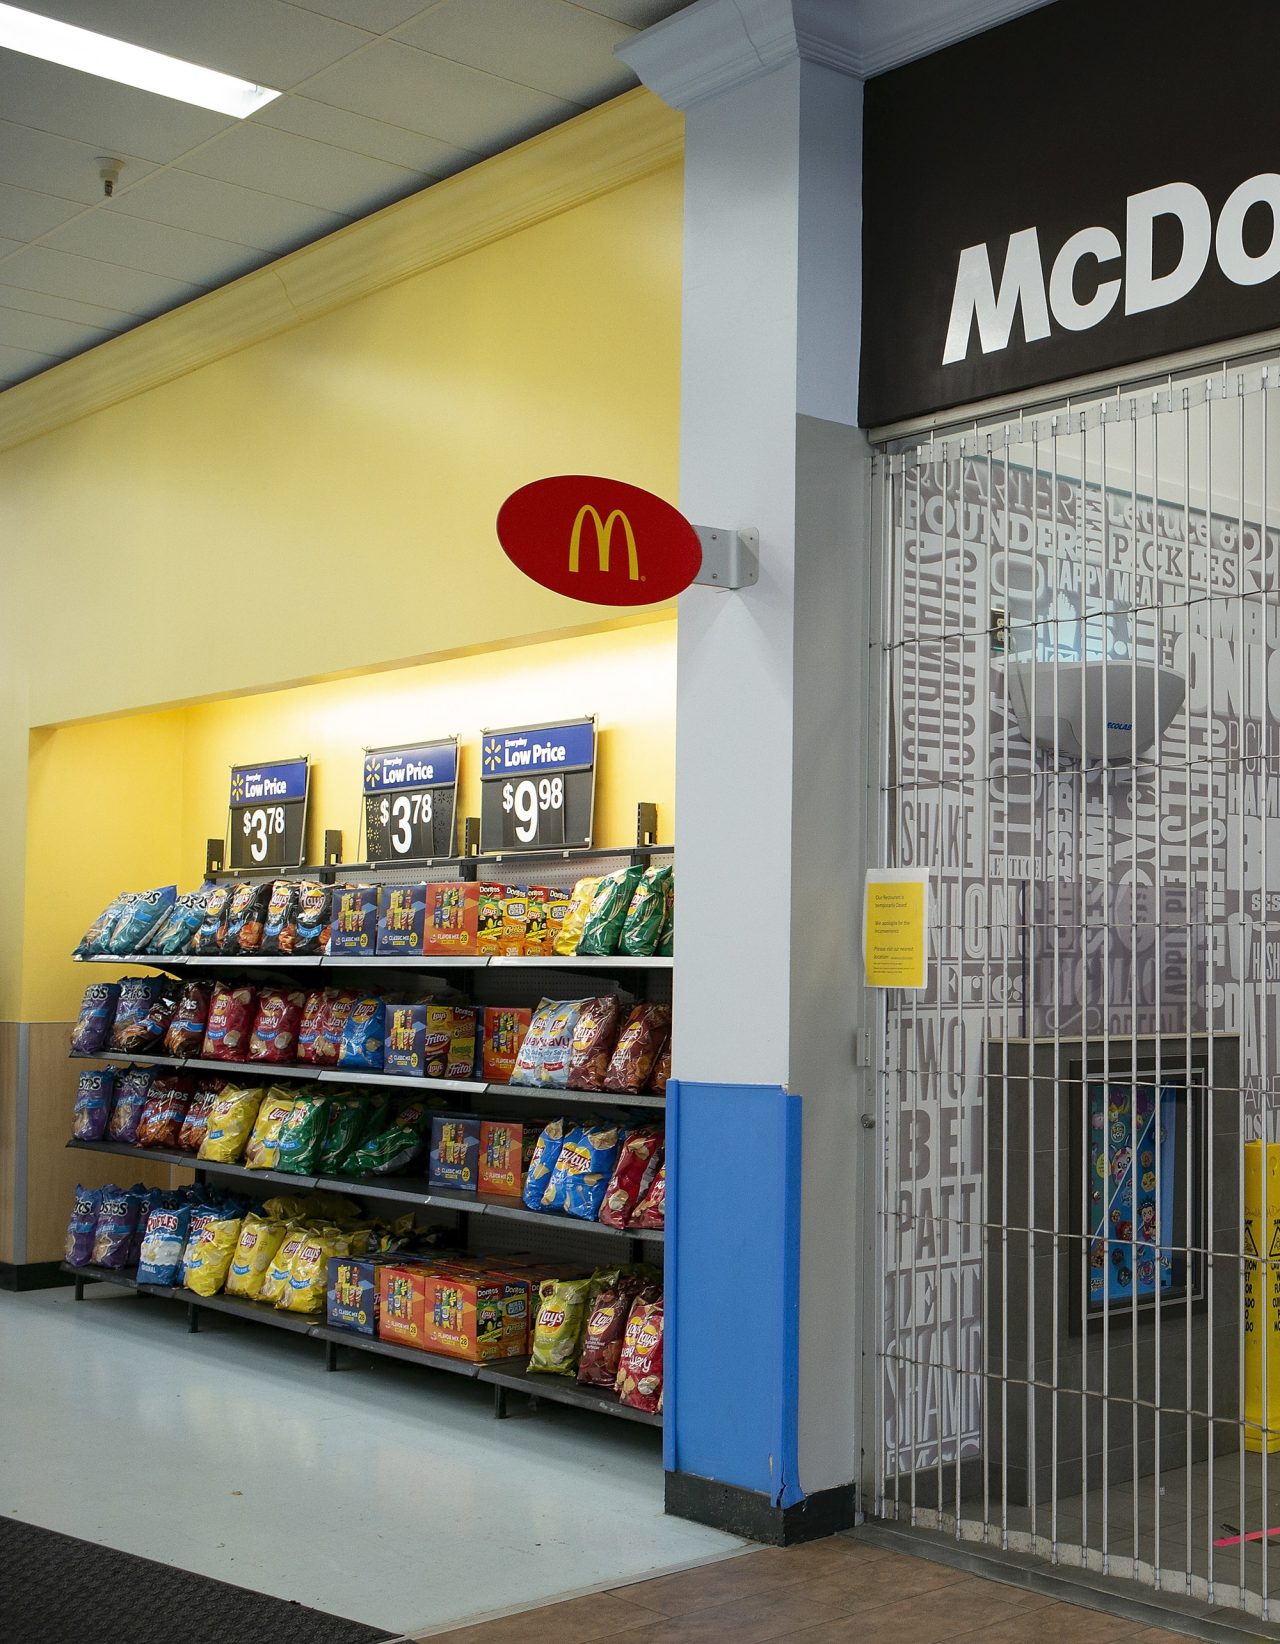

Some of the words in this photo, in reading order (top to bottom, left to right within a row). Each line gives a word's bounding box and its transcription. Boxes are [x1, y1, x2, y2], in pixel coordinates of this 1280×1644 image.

[900, 488, 1079, 562] POUNDER
[1108, 493, 1208, 546] Lettuce
[1112, 533, 1237, 589] PICKLES
[1113, 571, 1158, 607] MEA
[903, 539, 978, 796] SHAMROCK
[505, 738, 527, 749] Everyday
[1106, 721, 1133, 732] ECOLAB
[382, 766, 405, 784] Low
[406, 762, 433, 782] Price
[383, 757, 402, 767] Everyday
[505, 748, 531, 767] Low
[532, 742, 565, 762] Price
[245, 774, 261, 782] Everyday
[245, 782, 264, 797] Low
[264, 778, 287, 796] Price
[902, 800, 975, 868] SHAKE
[528, 889, 544, 897] oritos
[928, 882, 1042, 959] NIONS
[1252, 942, 1280, 980] HSH
[895, 1015, 966, 1103] TWO
[893, 1183, 982, 1263] PATT
